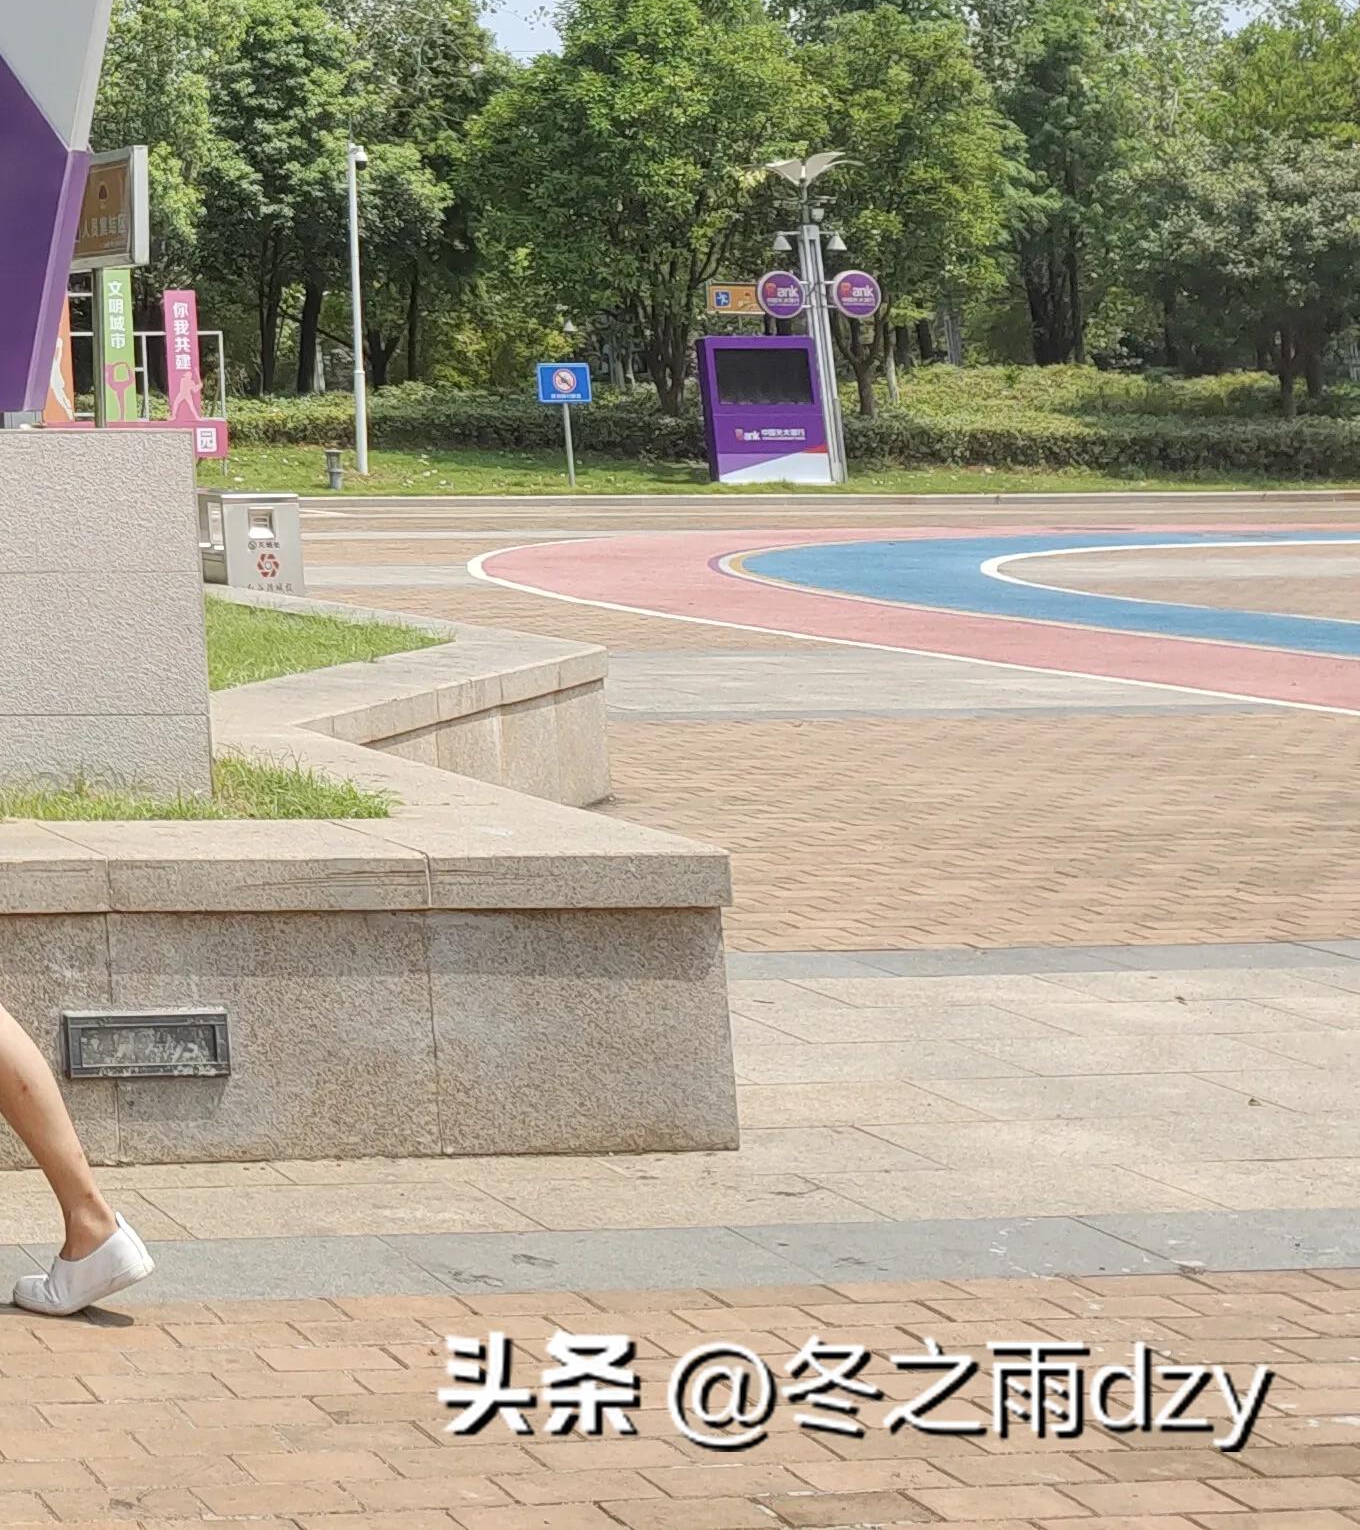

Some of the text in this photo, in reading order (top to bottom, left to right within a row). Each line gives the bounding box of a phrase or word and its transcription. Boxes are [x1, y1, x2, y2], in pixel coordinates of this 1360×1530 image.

[107, 280, 126, 349] 文明城市
[172, 302, 191, 370] 你我共建
